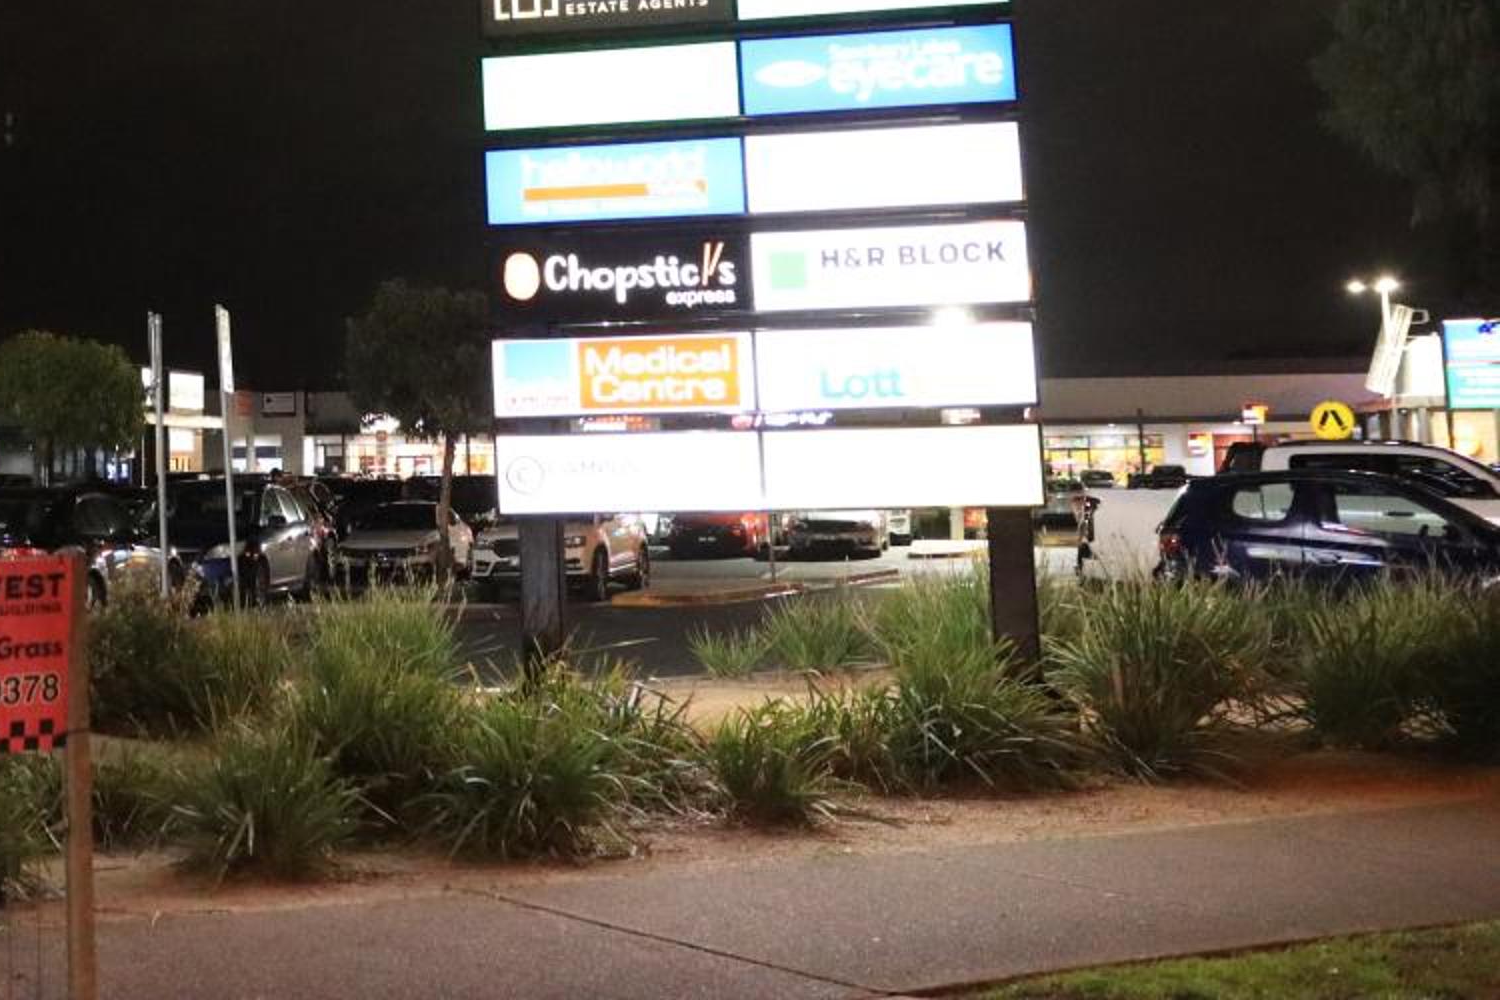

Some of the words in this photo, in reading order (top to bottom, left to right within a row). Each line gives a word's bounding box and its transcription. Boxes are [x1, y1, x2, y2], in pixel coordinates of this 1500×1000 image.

[565, 0, 629, 16] ESTATE
[828, 51, 1004, 103] eyecare
[821, 247, 885, 268] H&R
[899, 241, 1006, 265] BLOCK
[665, 289, 736, 308] express
[585, 343, 730, 376] Medical
[592, 375, 726, 402] Centre
[820, 368, 906, 399] Lott
